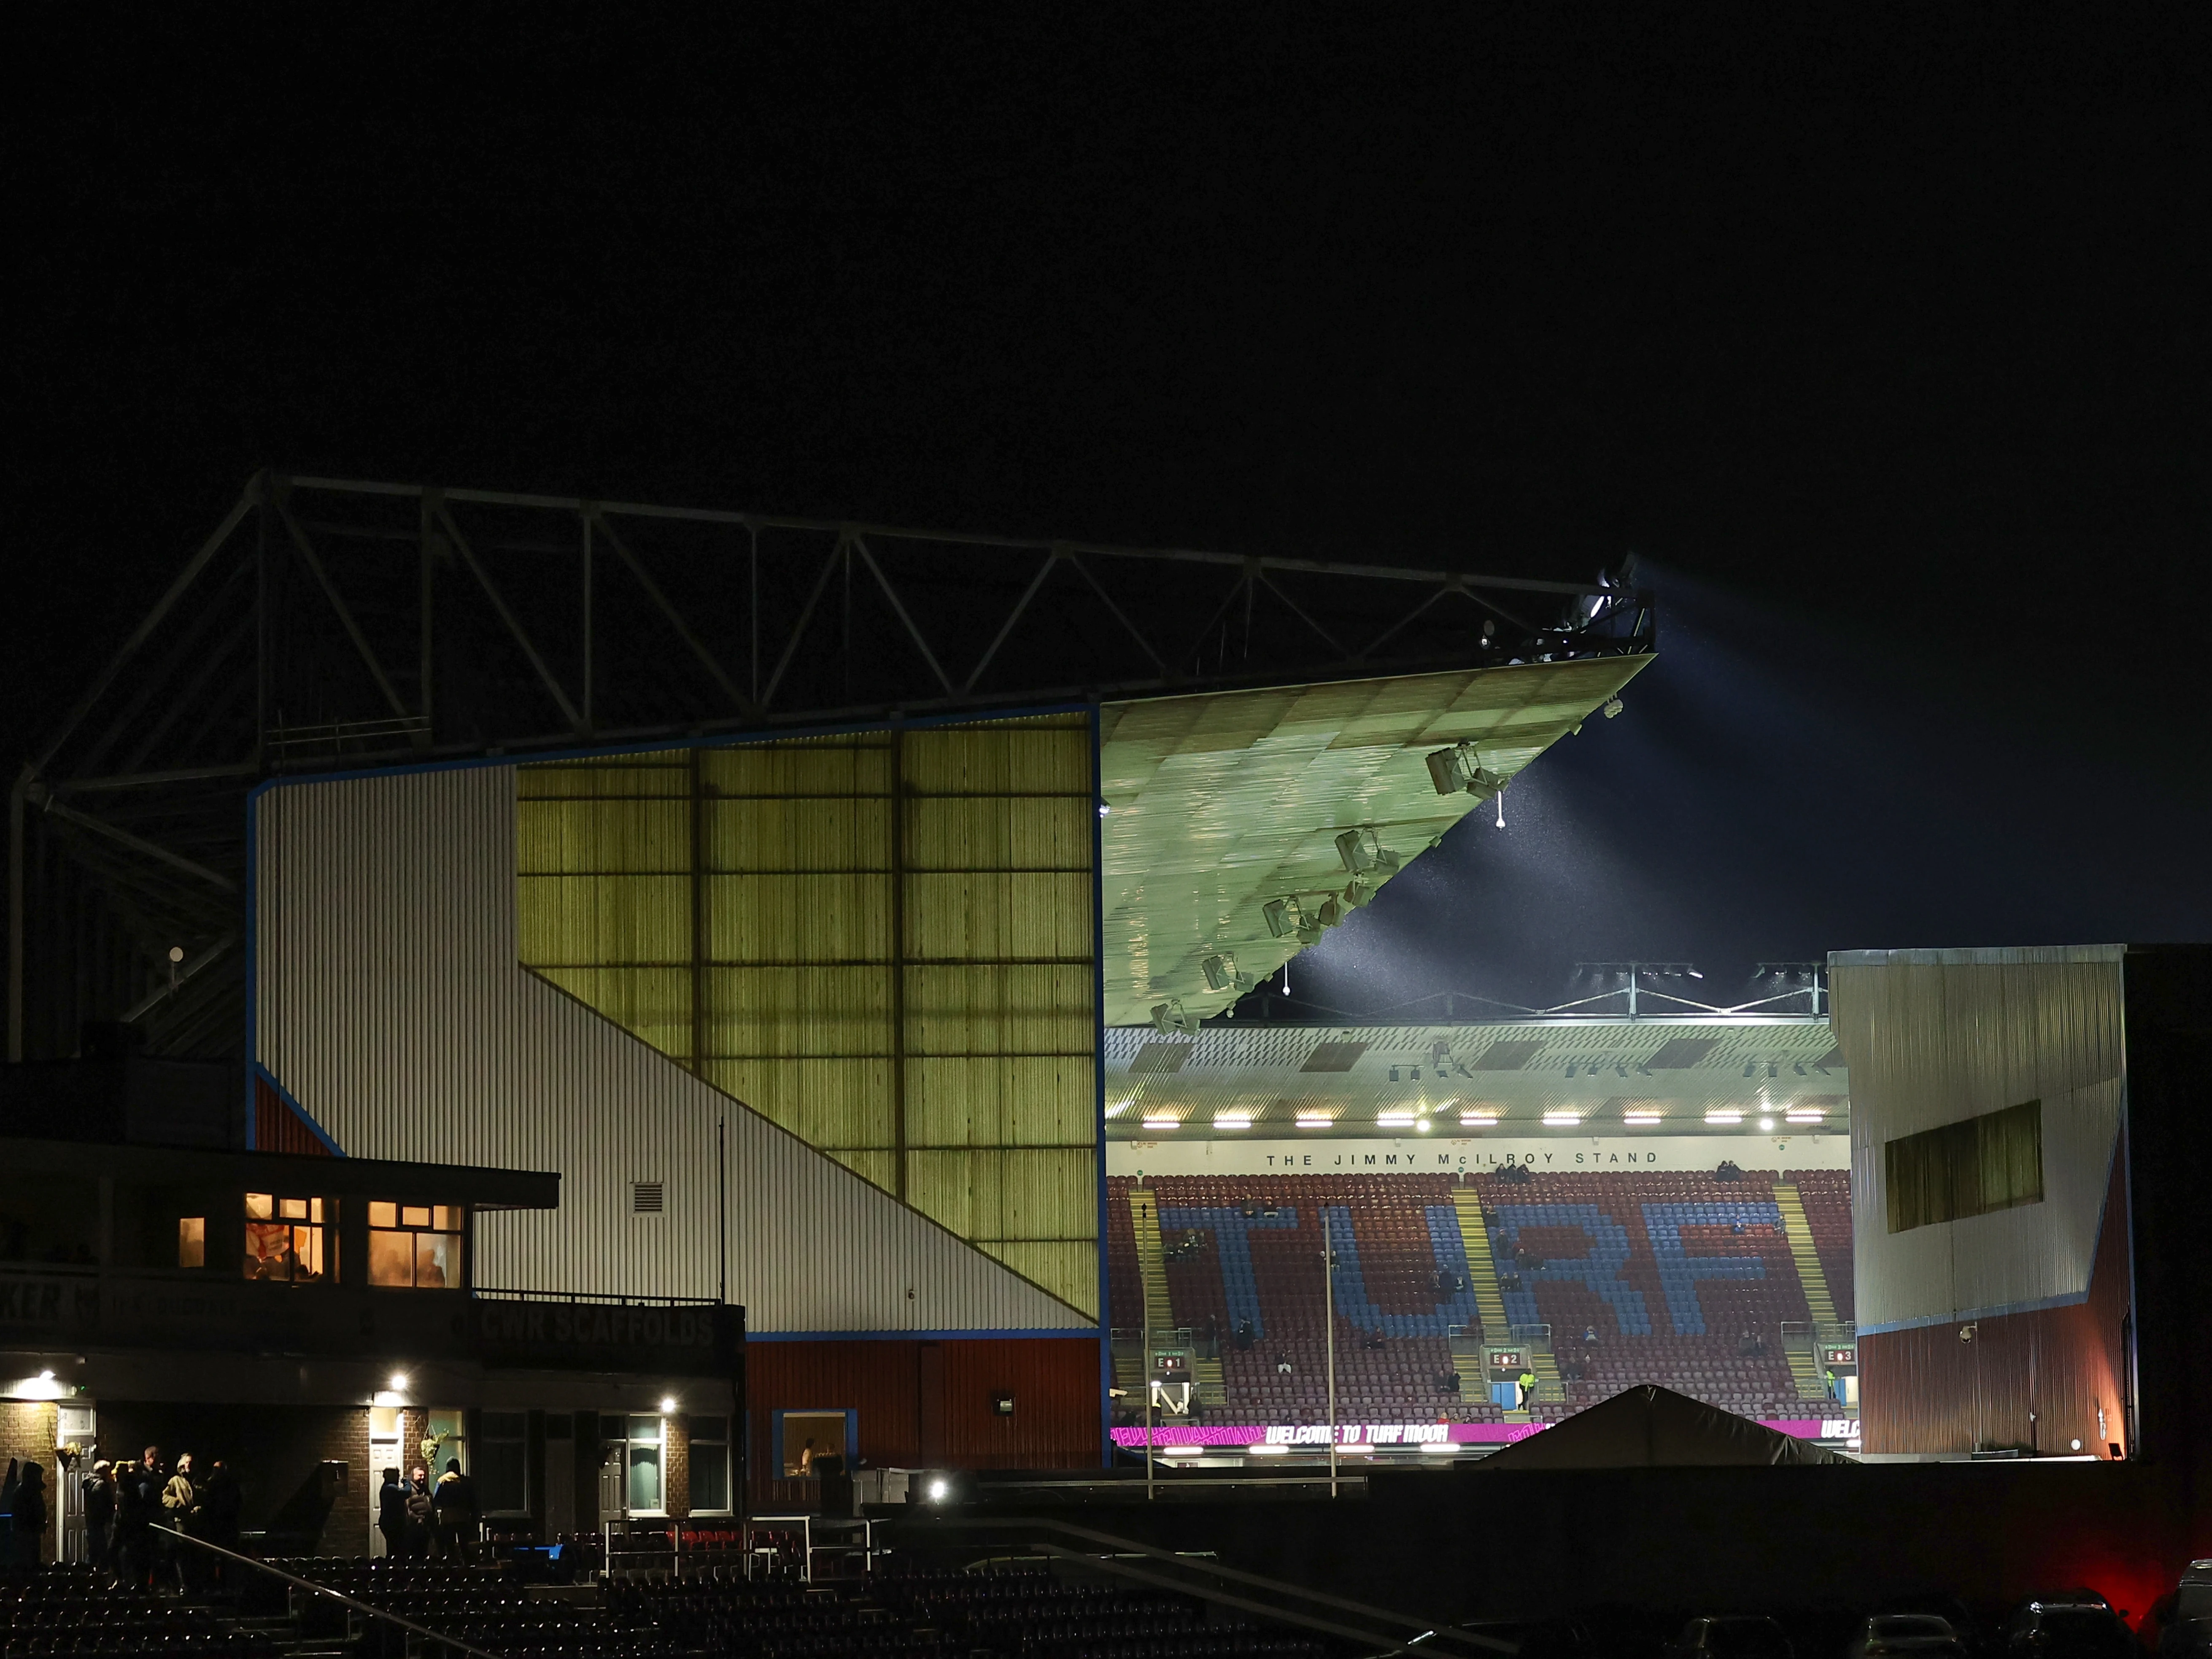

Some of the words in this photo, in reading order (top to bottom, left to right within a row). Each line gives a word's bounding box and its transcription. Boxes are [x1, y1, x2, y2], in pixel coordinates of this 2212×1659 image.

[1267, 1155, 1311, 1165] THE
[1335, 1155, 1416, 1165] JIMMY
[1438, 1153, 1553, 1164] McILROY
[1575, 1152, 1656, 1163] STAND
[1159, 1202, 1780, 1338] TURF
[555, 1306, 714, 1346] SCAFFOLDS
[1265, 1425, 1338, 1444] WELCOME
[1342, 1425, 1362, 1443] TO
[1366, 1424, 1403, 1443] TURF
[1403, 1424, 1449, 1442] MOOR
